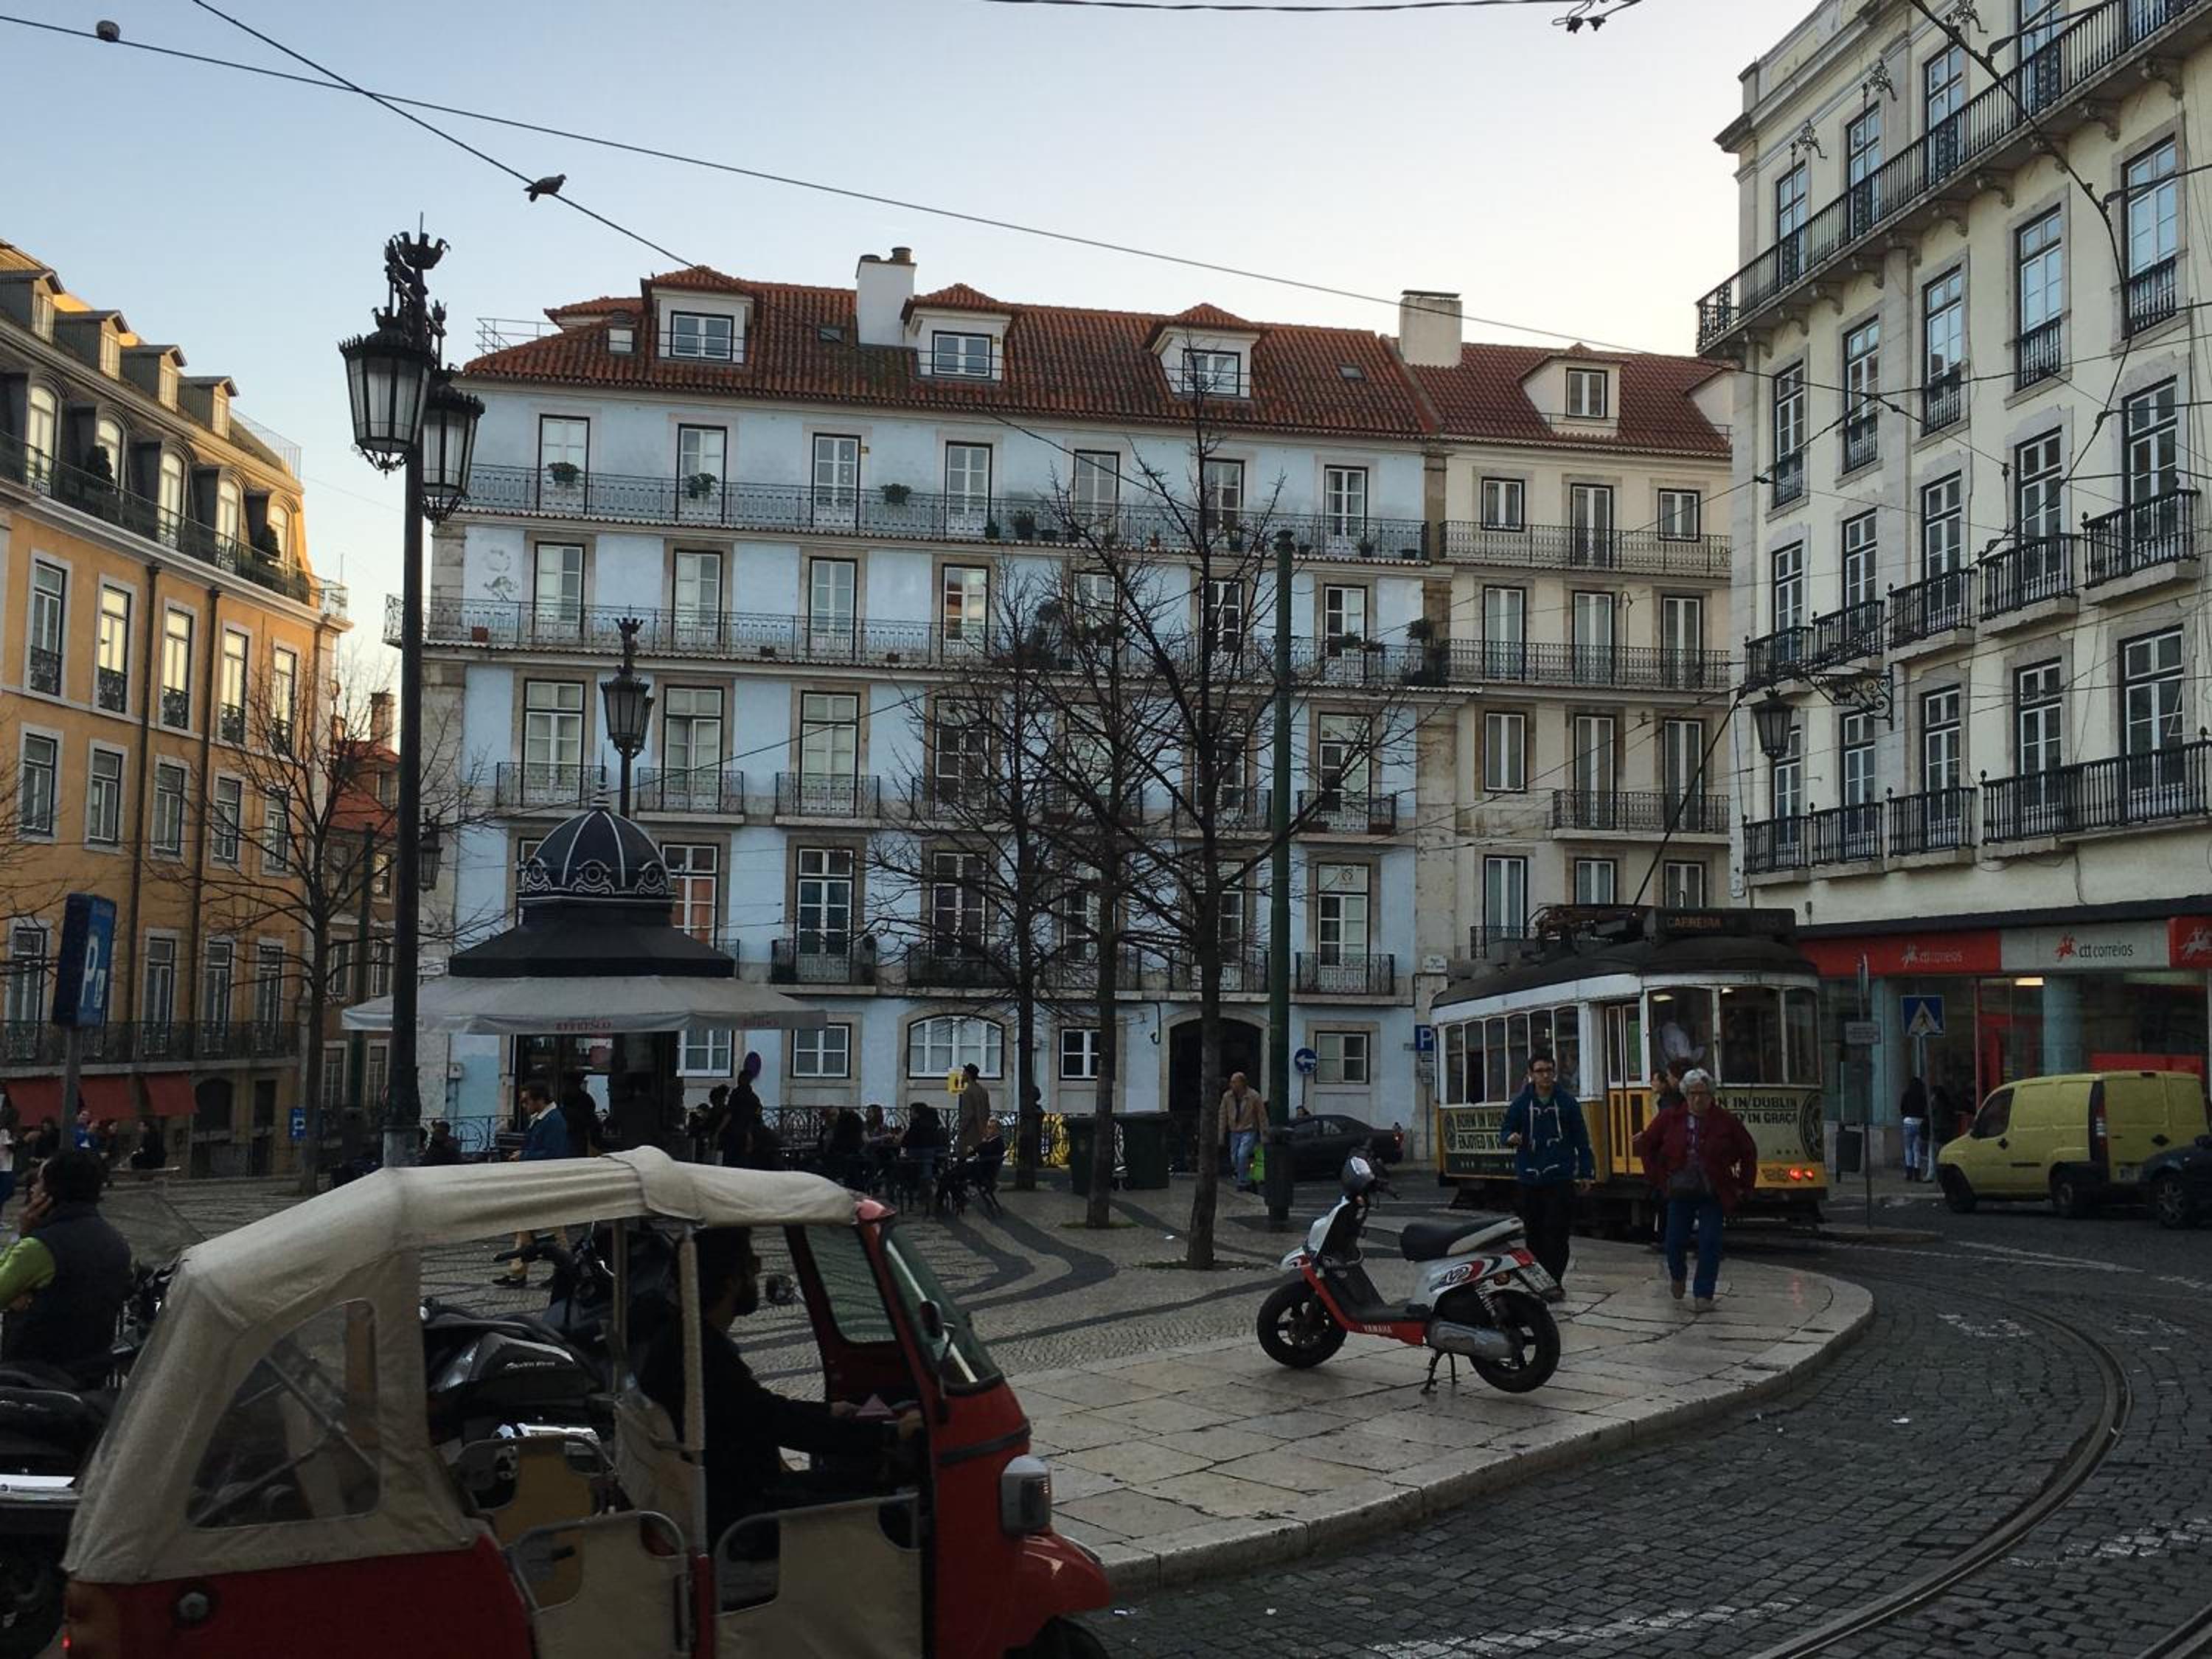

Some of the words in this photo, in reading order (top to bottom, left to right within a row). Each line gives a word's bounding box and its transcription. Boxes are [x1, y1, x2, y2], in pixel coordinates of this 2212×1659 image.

[2079, 944, 2091, 958] ctt
[2093, 942, 2133, 957] correios
[1419, 1027, 1433, 1049] P
[1753, 1097, 1798, 1107] DUBLIN
[1763, 1113, 1798, 1125] GRAÇA
[1363, 1324, 1393, 1334] YAMAHA
